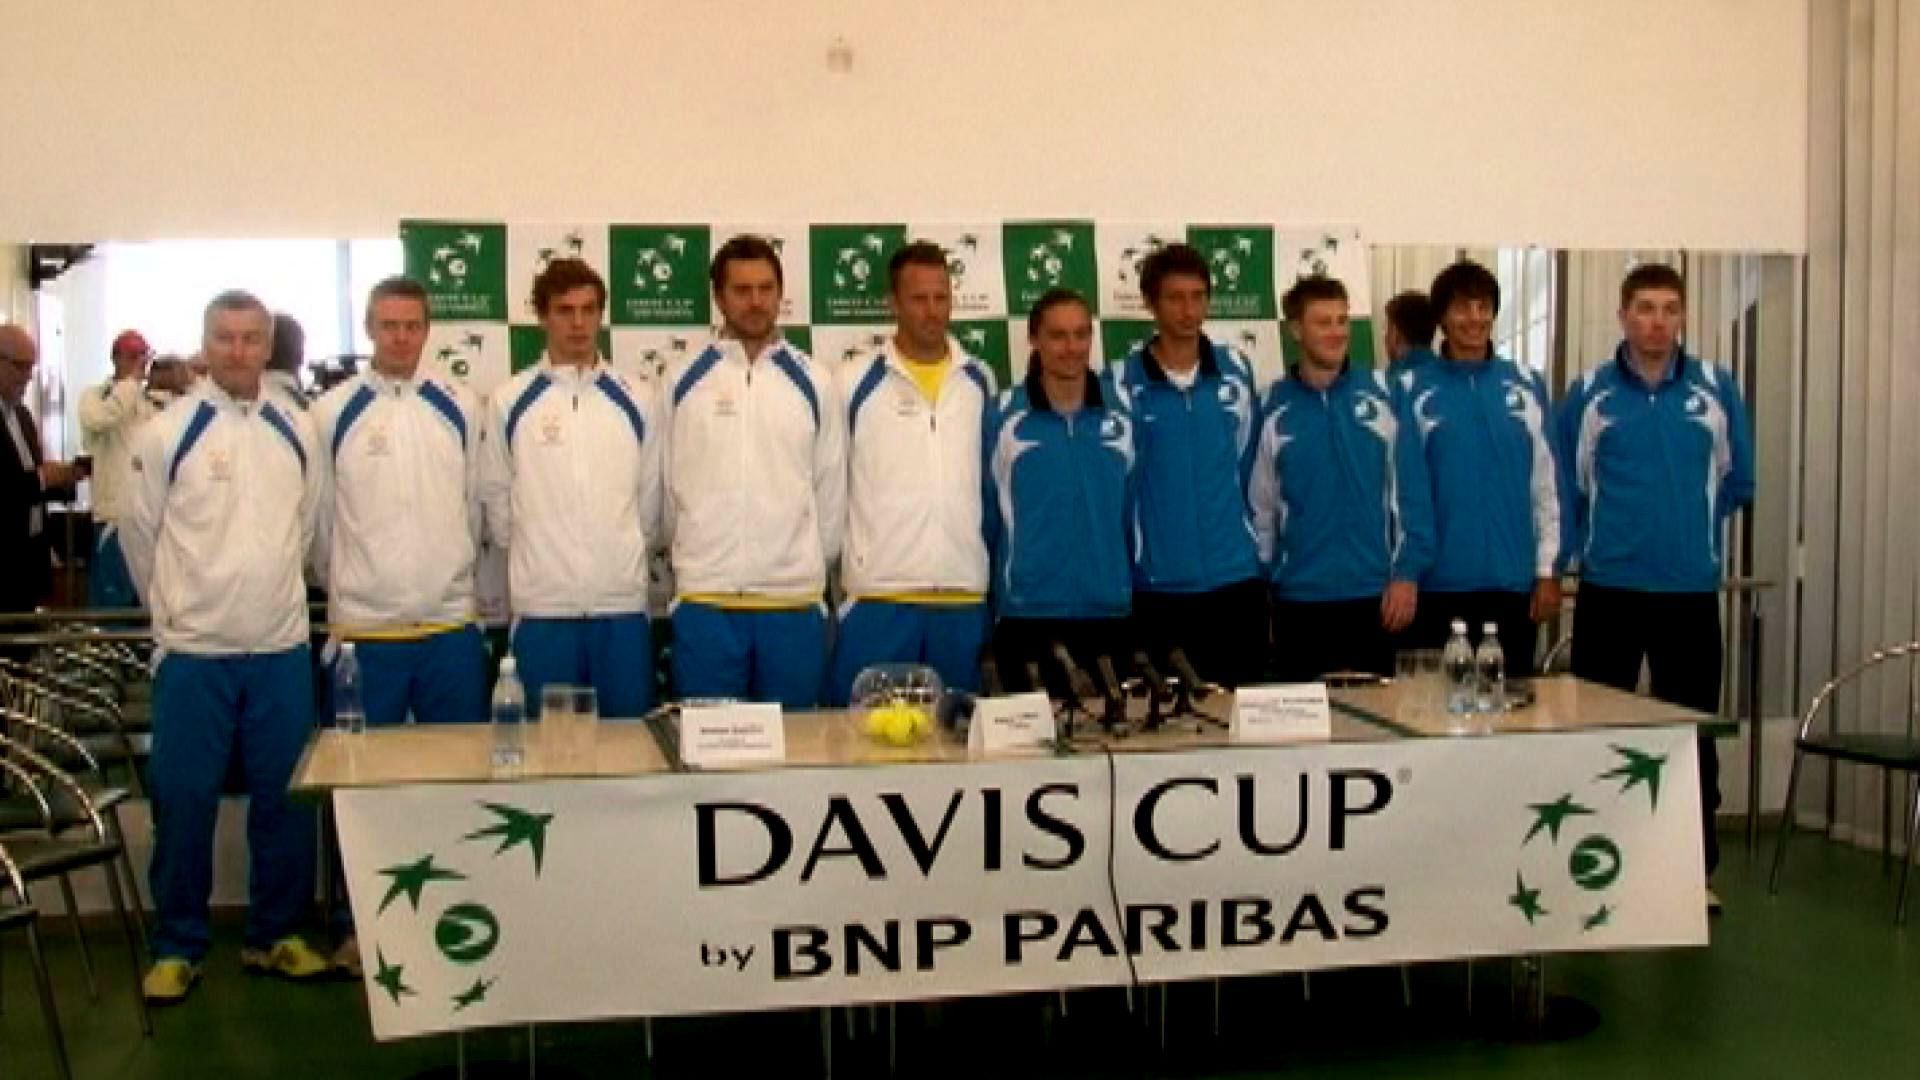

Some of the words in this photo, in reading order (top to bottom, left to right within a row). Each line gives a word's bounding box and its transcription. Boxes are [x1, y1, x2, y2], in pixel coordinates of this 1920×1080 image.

[693, 782, 1085, 888] DAVIS
[1132, 769, 1394, 862] CUP
[700, 942, 754, 972] by
[771, 916, 972, 981] BNP
[1002, 885, 1390, 965] PARIBAS
